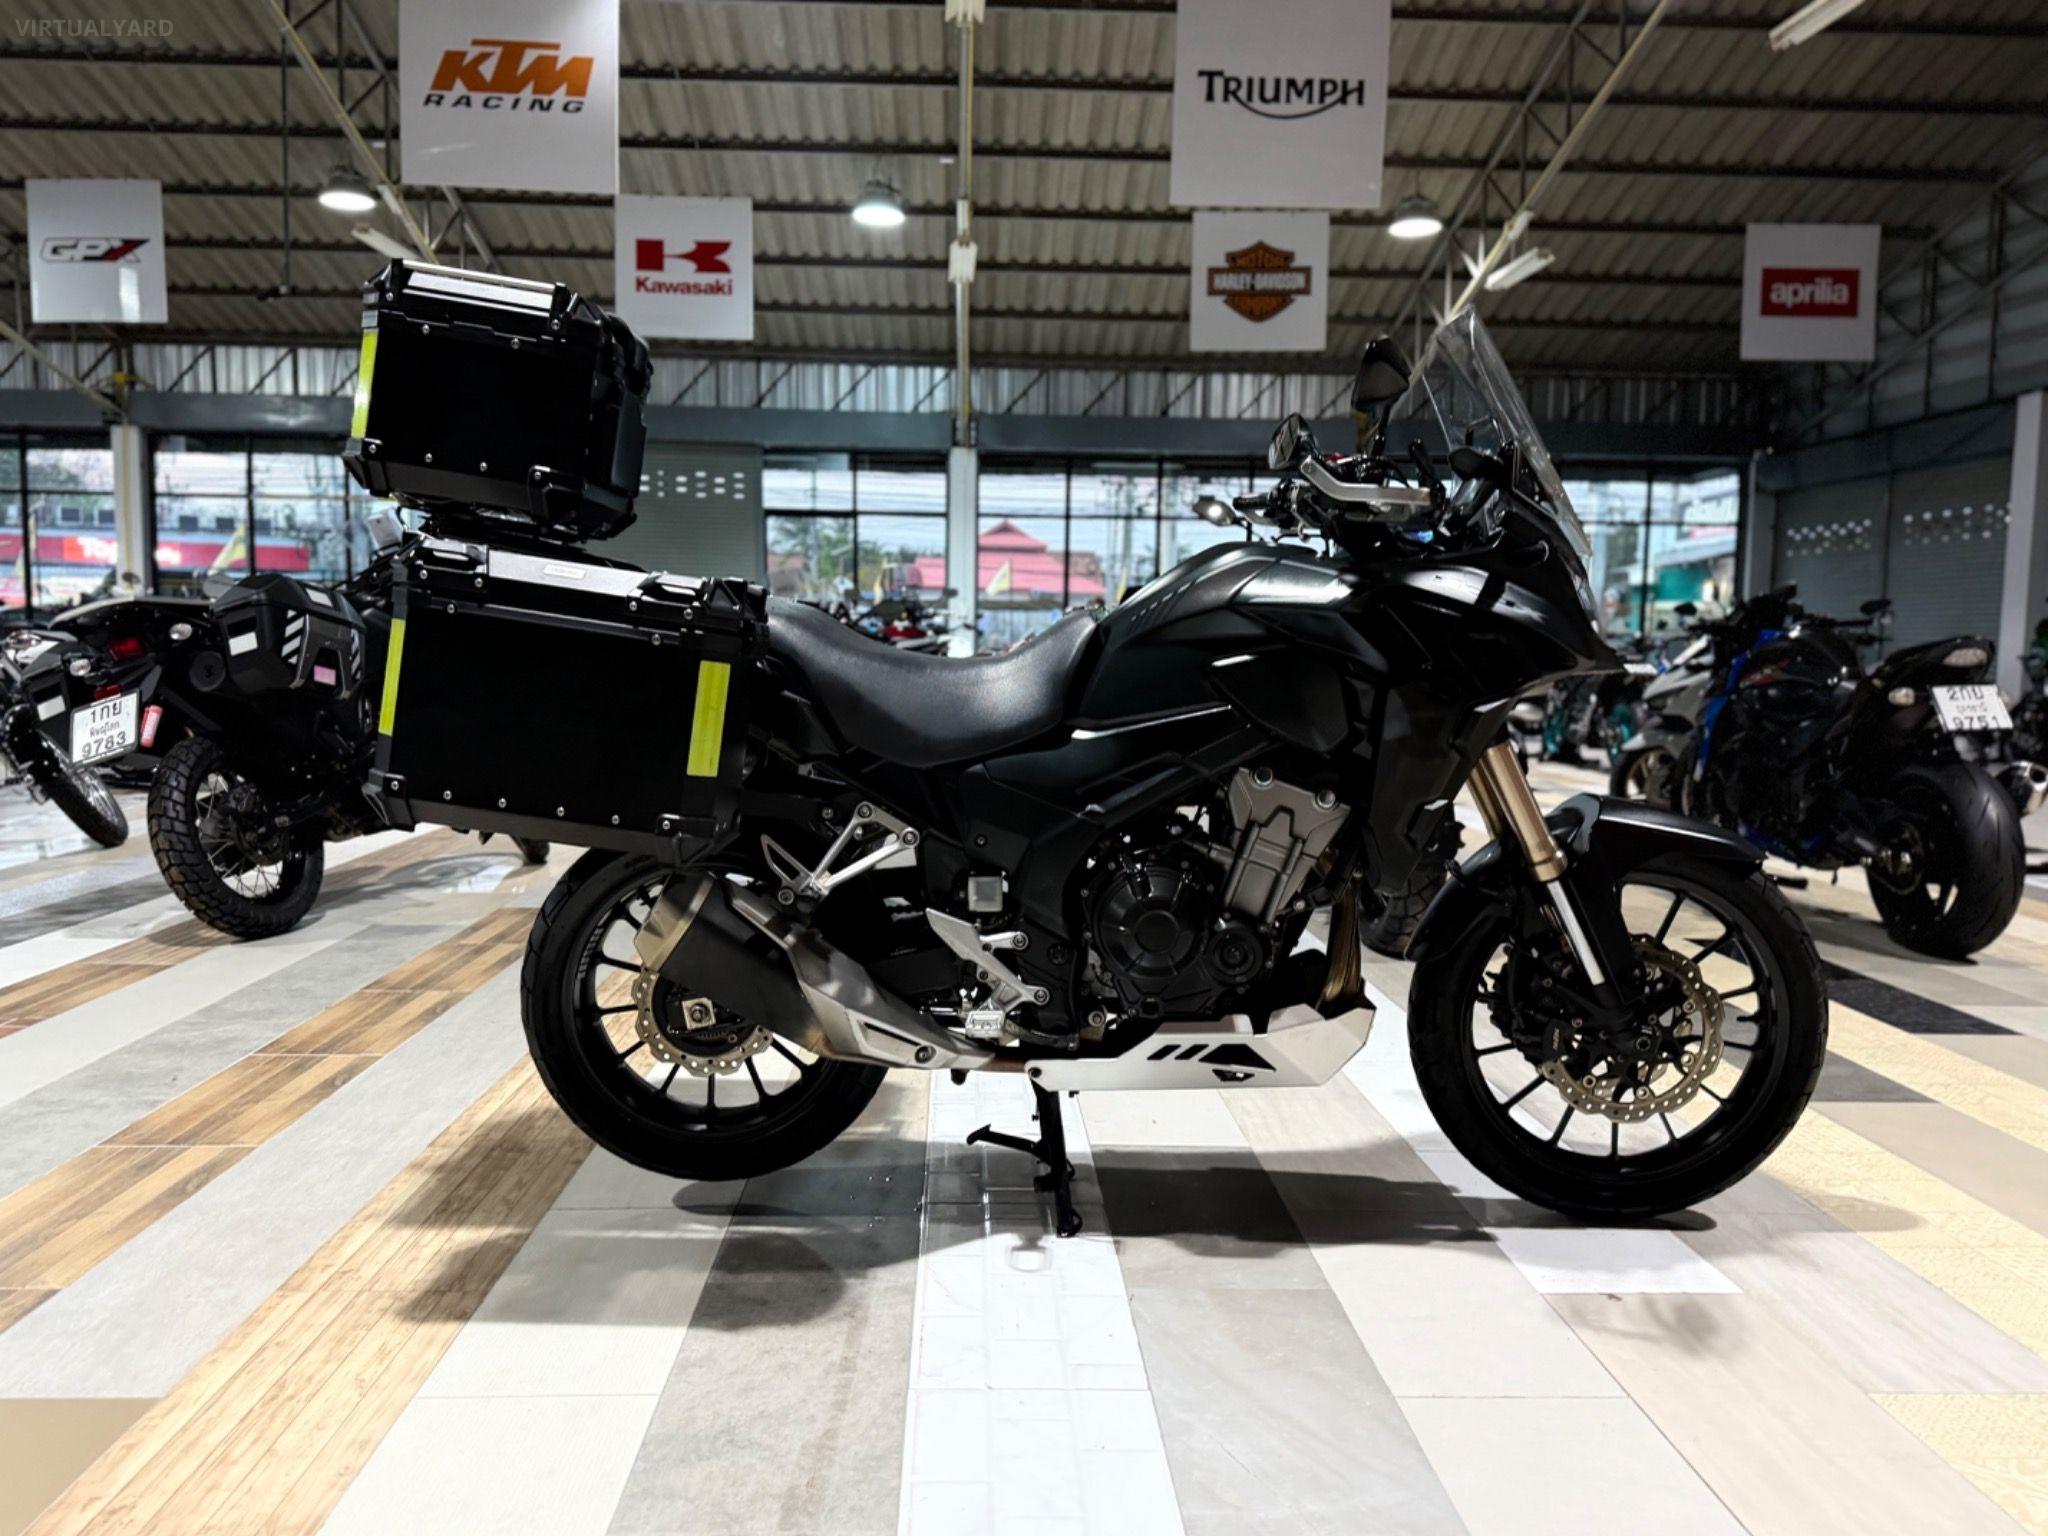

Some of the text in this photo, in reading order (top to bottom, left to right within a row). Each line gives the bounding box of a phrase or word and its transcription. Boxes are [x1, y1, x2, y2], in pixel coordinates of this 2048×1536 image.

[431, 39, 594, 98] KTM
[423, 93, 584, 113] RACING
[1198, 70, 1365, 118] TRIUMPH
[40, 238, 150, 262] GPX
[636, 276, 733, 295] Kawasaki
[1770, 277, 1849, 308] aprilia
[82, 731, 126, 758] 9783
